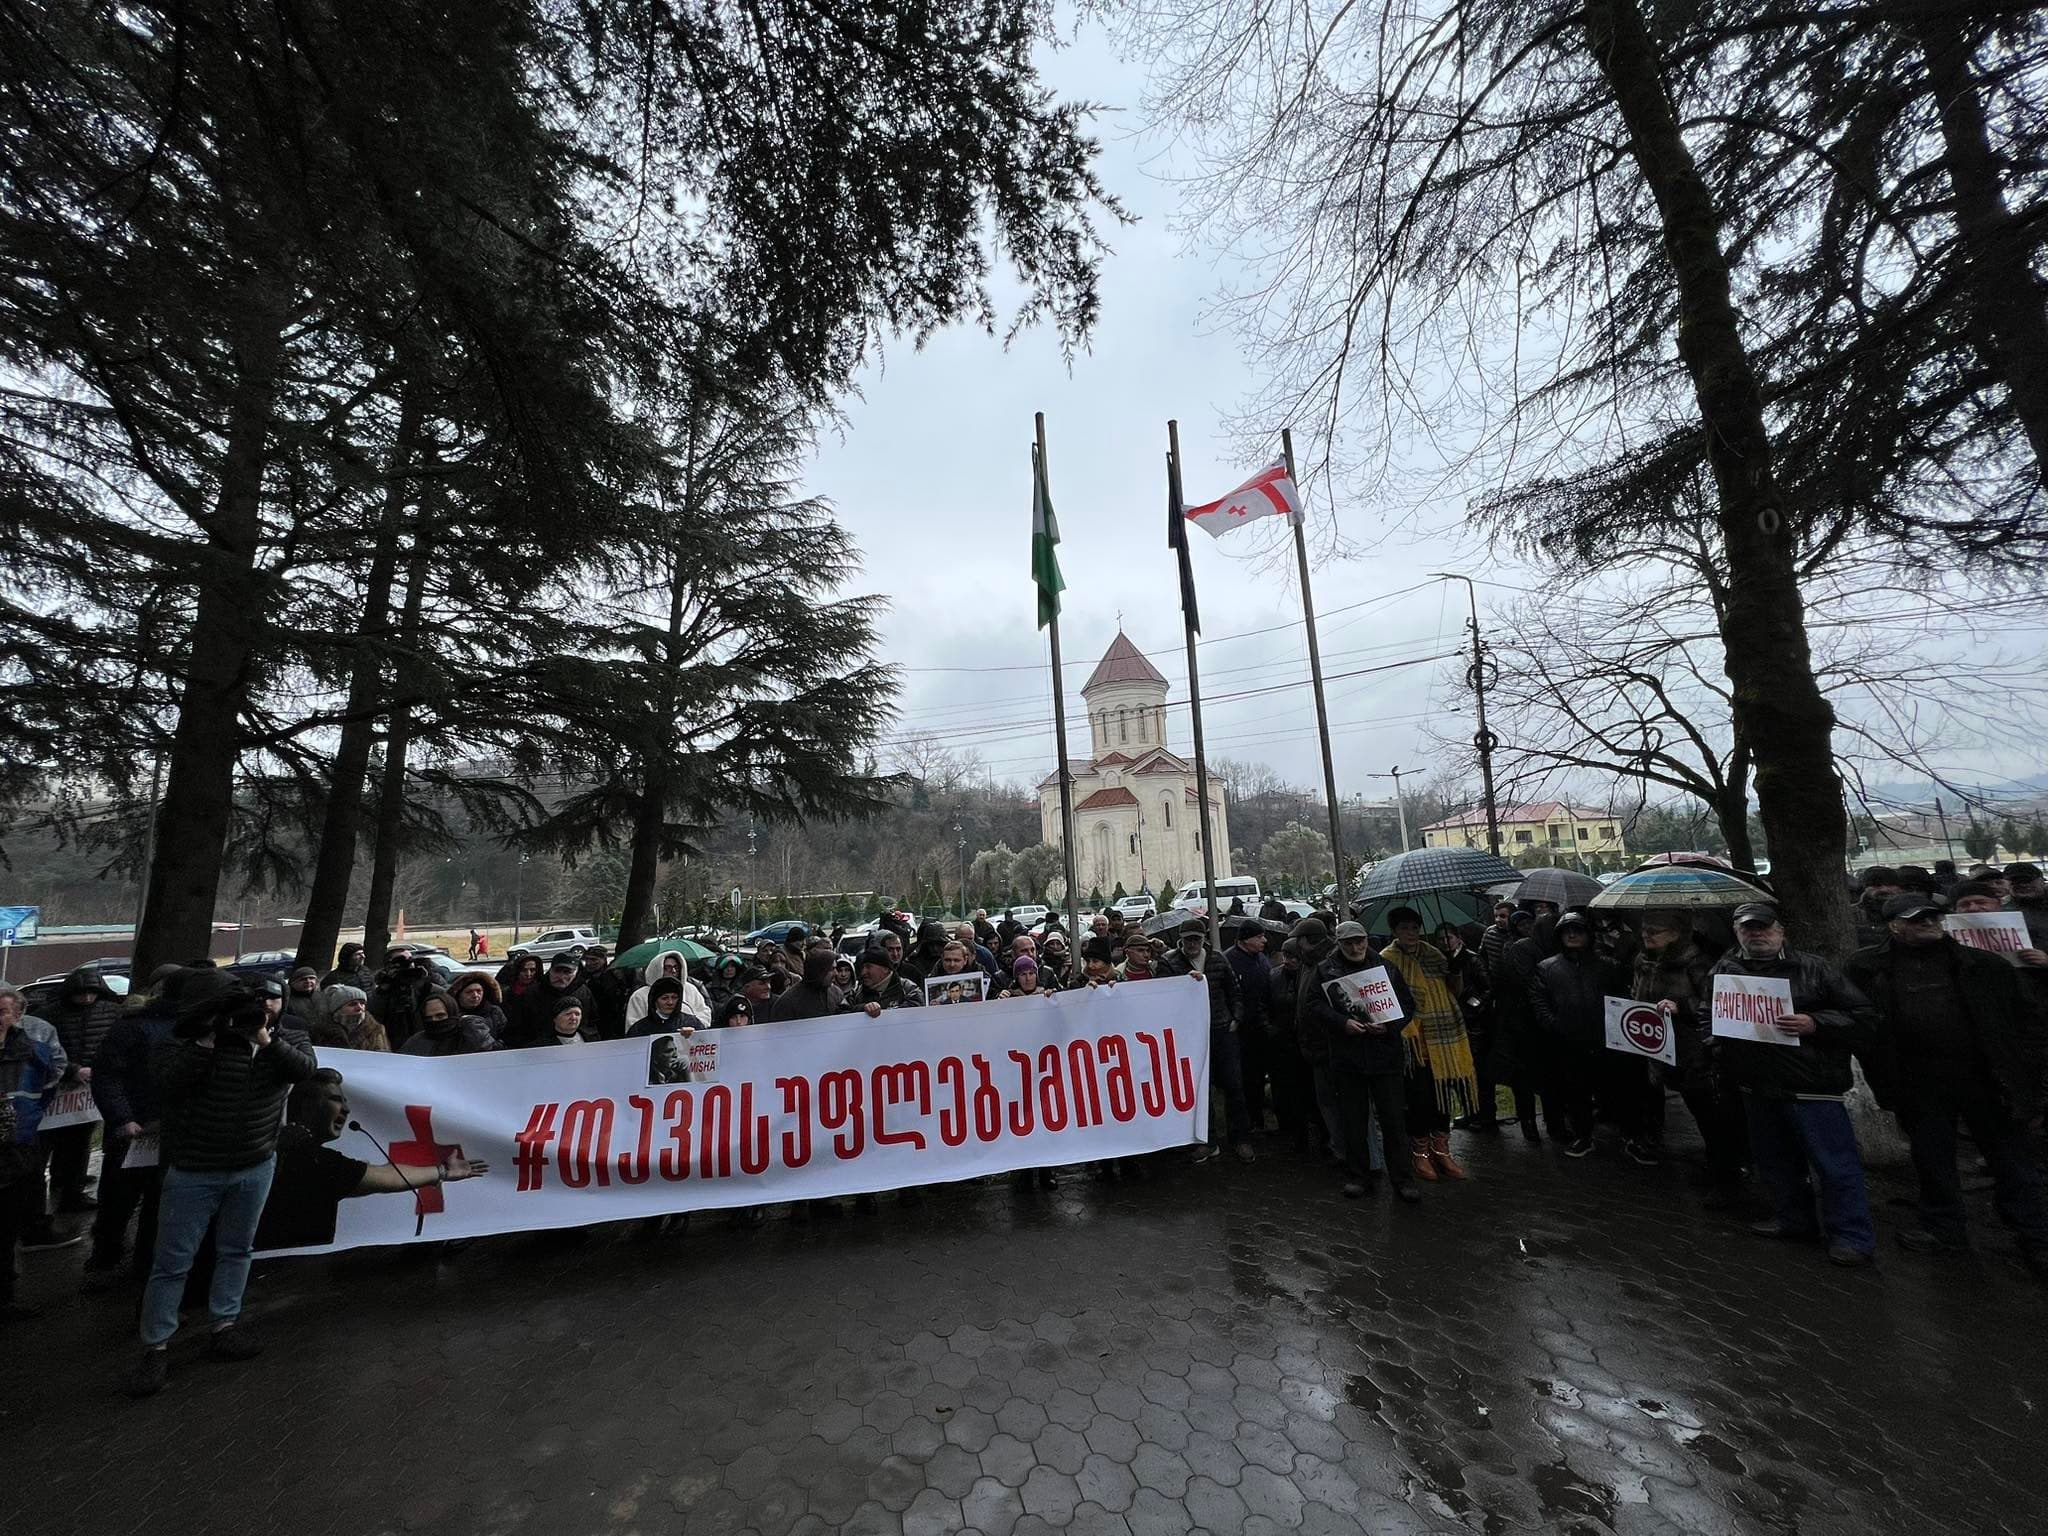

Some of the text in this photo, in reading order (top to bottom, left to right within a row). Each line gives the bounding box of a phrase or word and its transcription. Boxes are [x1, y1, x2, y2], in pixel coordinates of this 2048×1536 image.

[1359, 981, 1389, 998] #FREE
[1366, 998, 1396, 1014] MISHA
[1628, 1020, 1664, 1040] SOS
[689, 1044, 717, 1057] #FREE
[688, 1060, 716, 1073] MISHA
[512, 1028, 1196, 1192] #თავისუფლებამიშას
